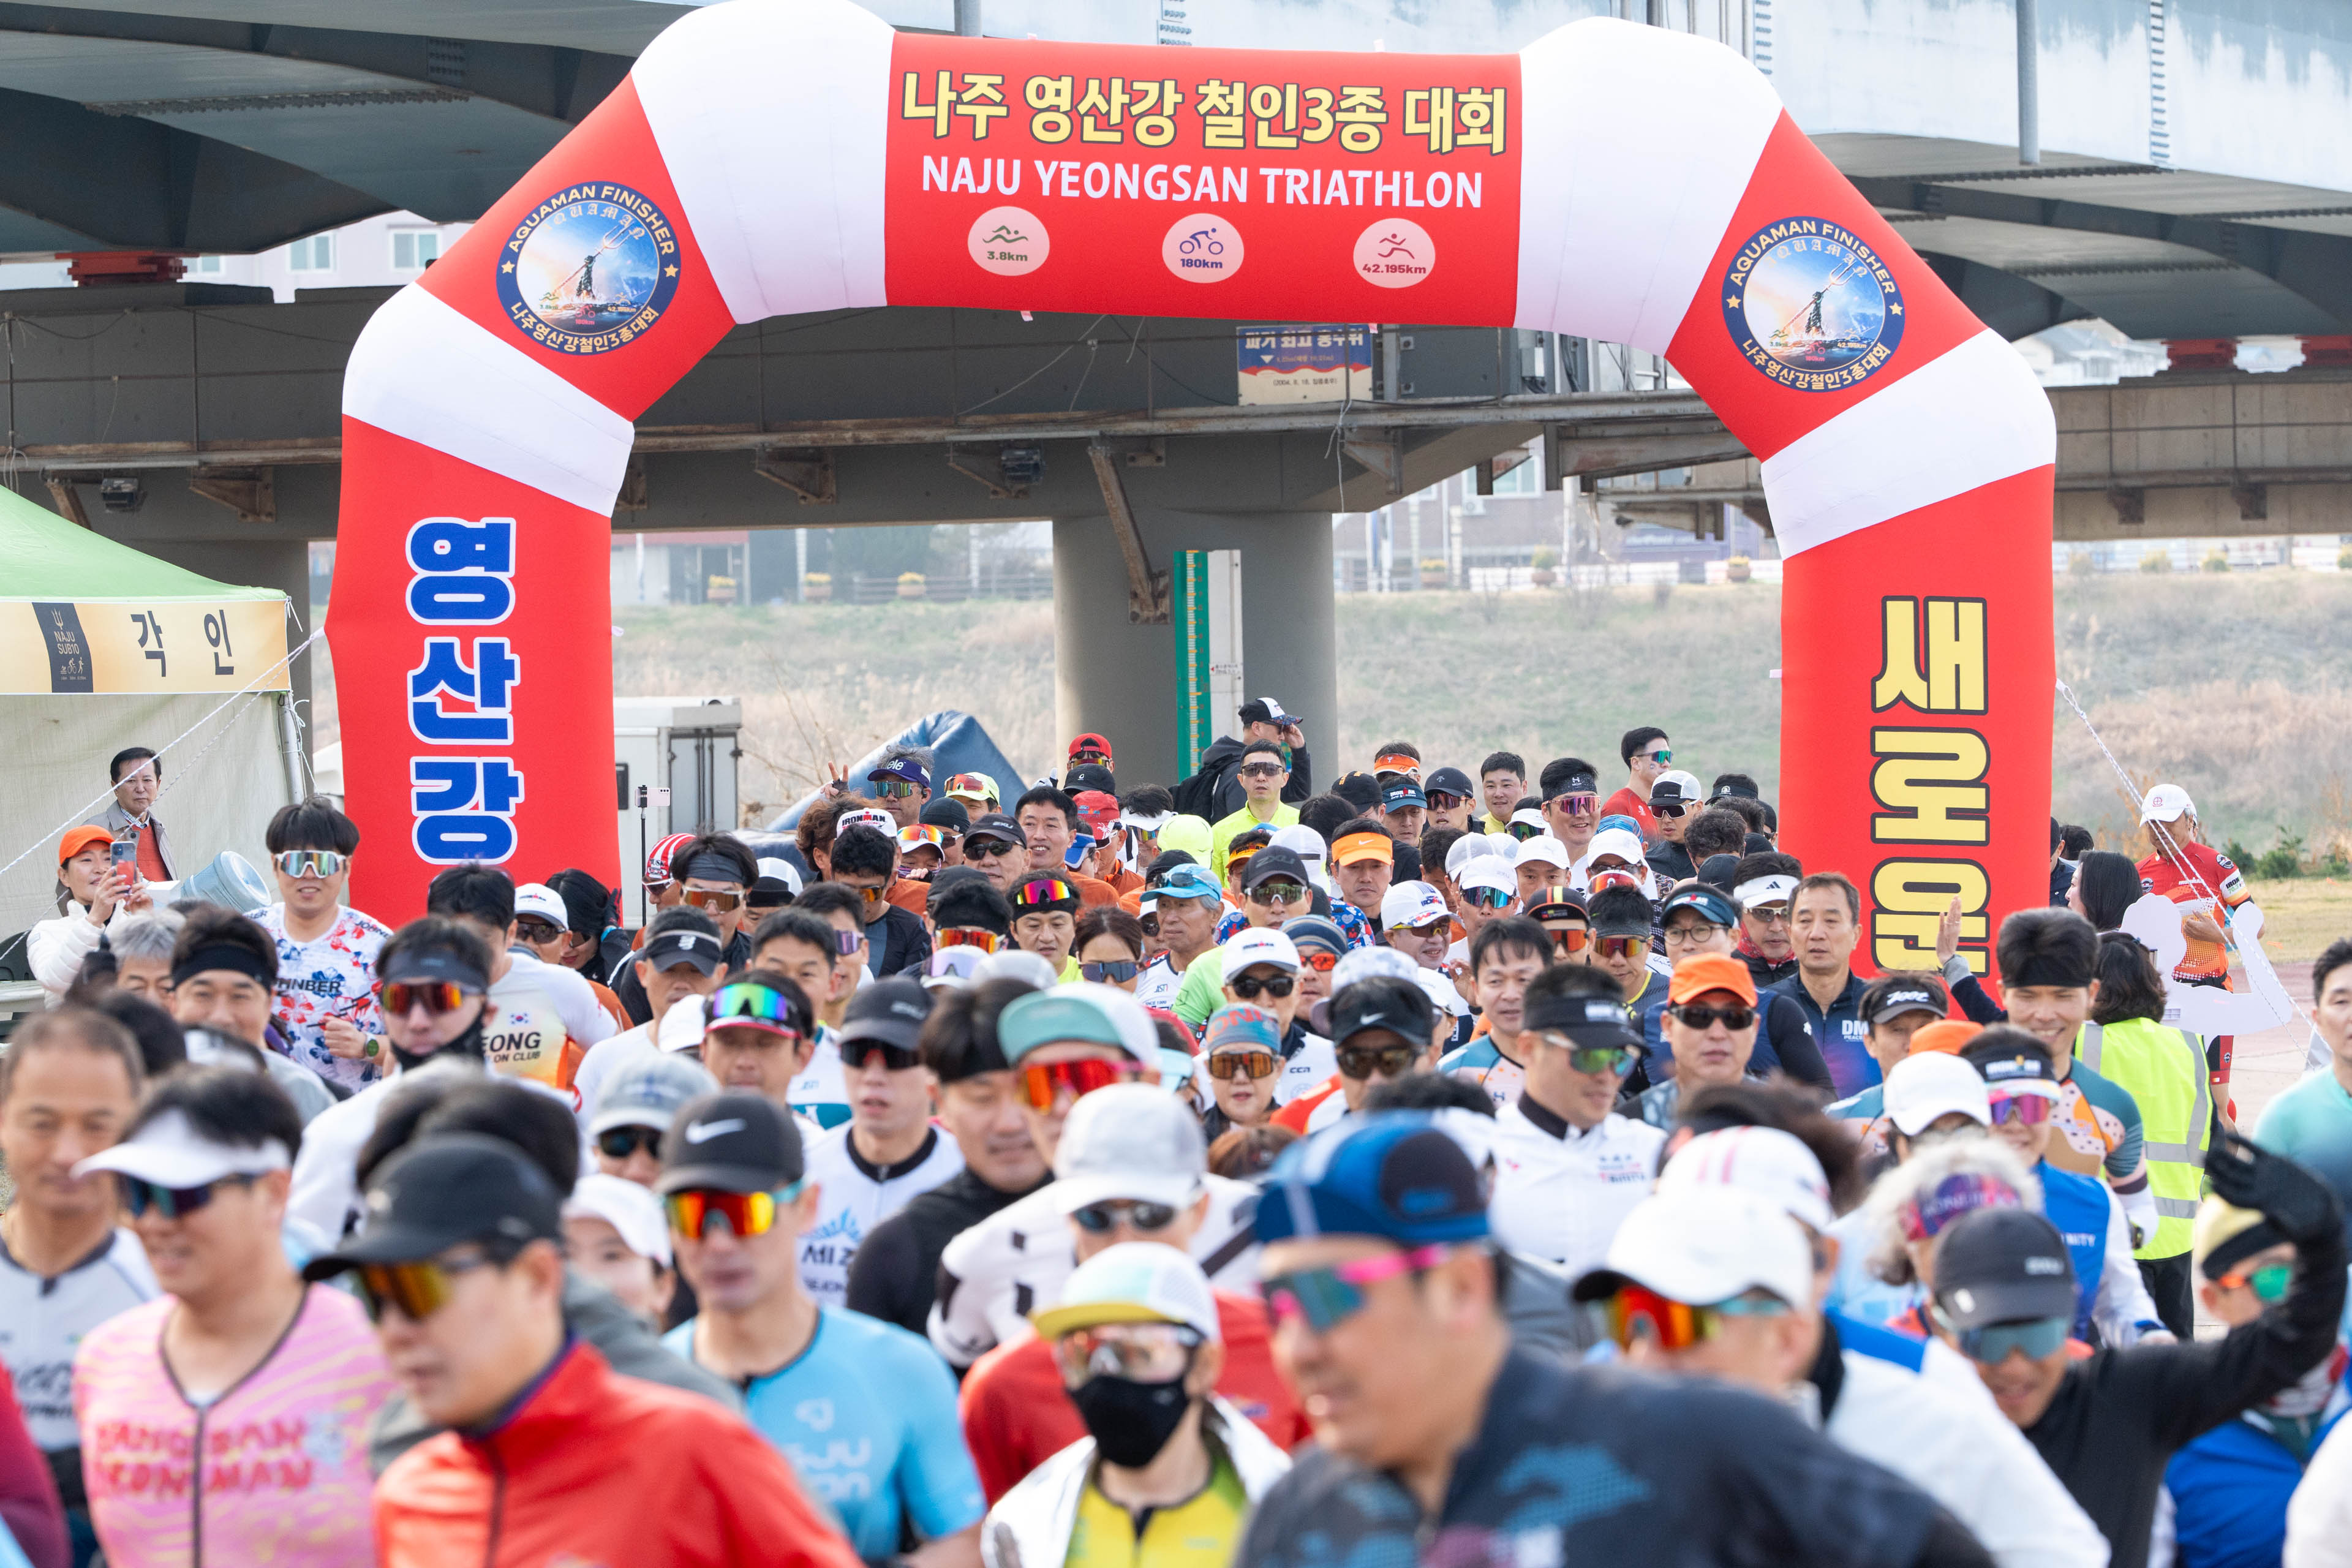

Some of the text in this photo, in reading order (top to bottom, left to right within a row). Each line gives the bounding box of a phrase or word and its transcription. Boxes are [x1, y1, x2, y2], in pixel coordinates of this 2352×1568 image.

[902, 70, 1507, 157] 나주 영산강 철인3종 대회
[922, 156, 1483, 208] NAJU YEONGSAN TRIATHLON
[508, 185, 675, 255] AQUAMAN FINISHER
[986, 251, 1028, 262] 3.8km
[1180, 257, 1224, 270] 180km
[1730, 220, 1895, 293] AQUAMAN FINISHER
[1362, 263, 1427, 276] 42.195km
[54, 631, 75, 642] NAJU
[58, 643, 80, 654] SUB10
[405, 516, 525, 865] 영산강
[842, 811, 886, 826] IRONMAN
